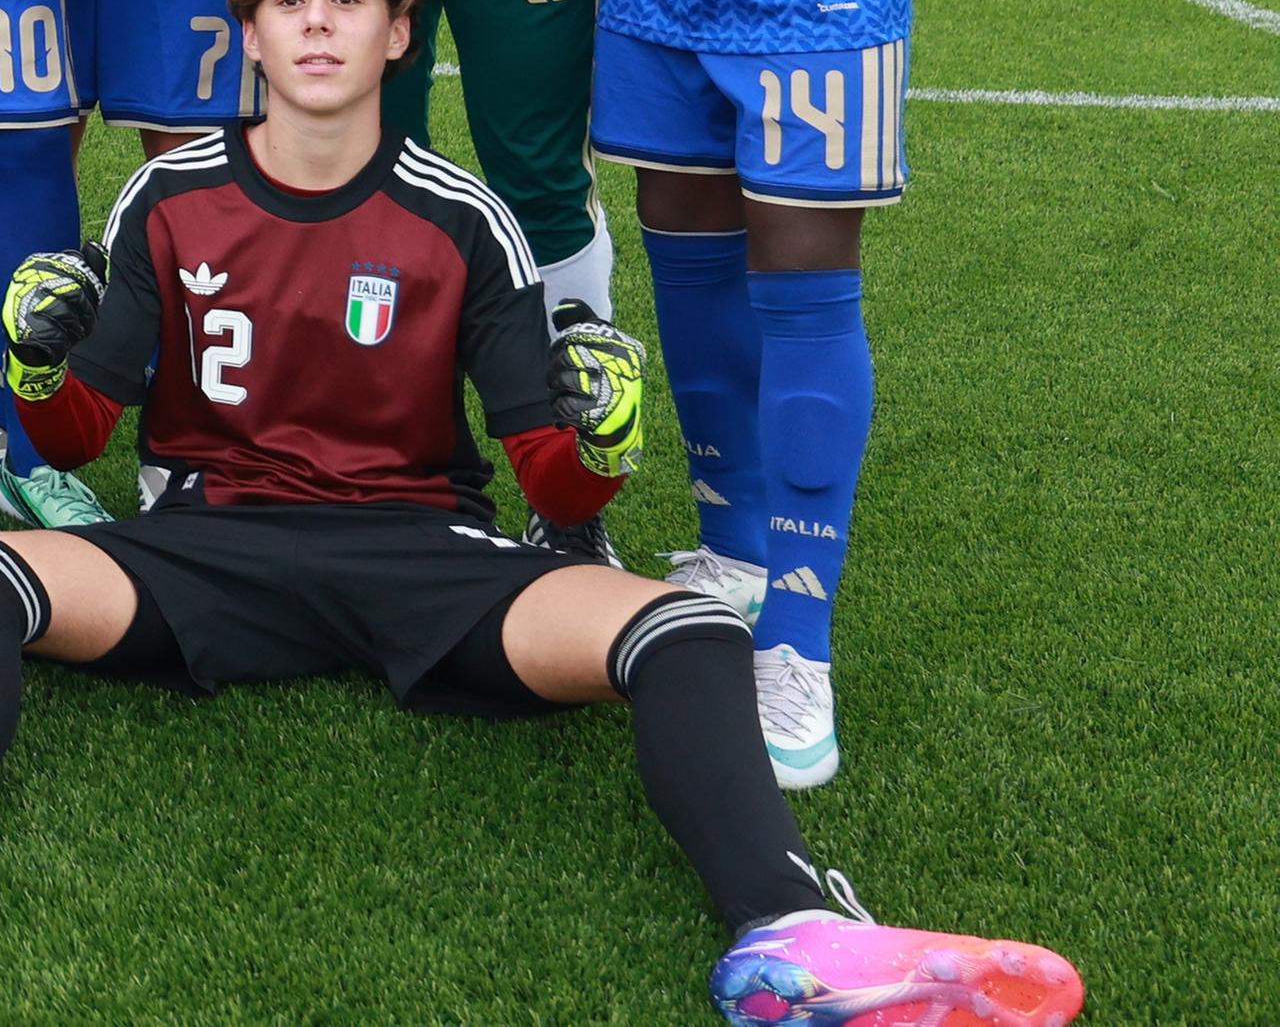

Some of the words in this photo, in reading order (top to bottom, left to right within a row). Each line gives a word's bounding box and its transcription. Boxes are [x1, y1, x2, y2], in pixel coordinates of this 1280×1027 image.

[190, 16, 230, 100] 7
[759, 70, 844, 170] 14
[352, 279, 392, 297] ITALIA
[185, 302, 252, 406] 2
[687, 440, 721, 457] LIA
[770, 516, 838, 540] ITALIA
